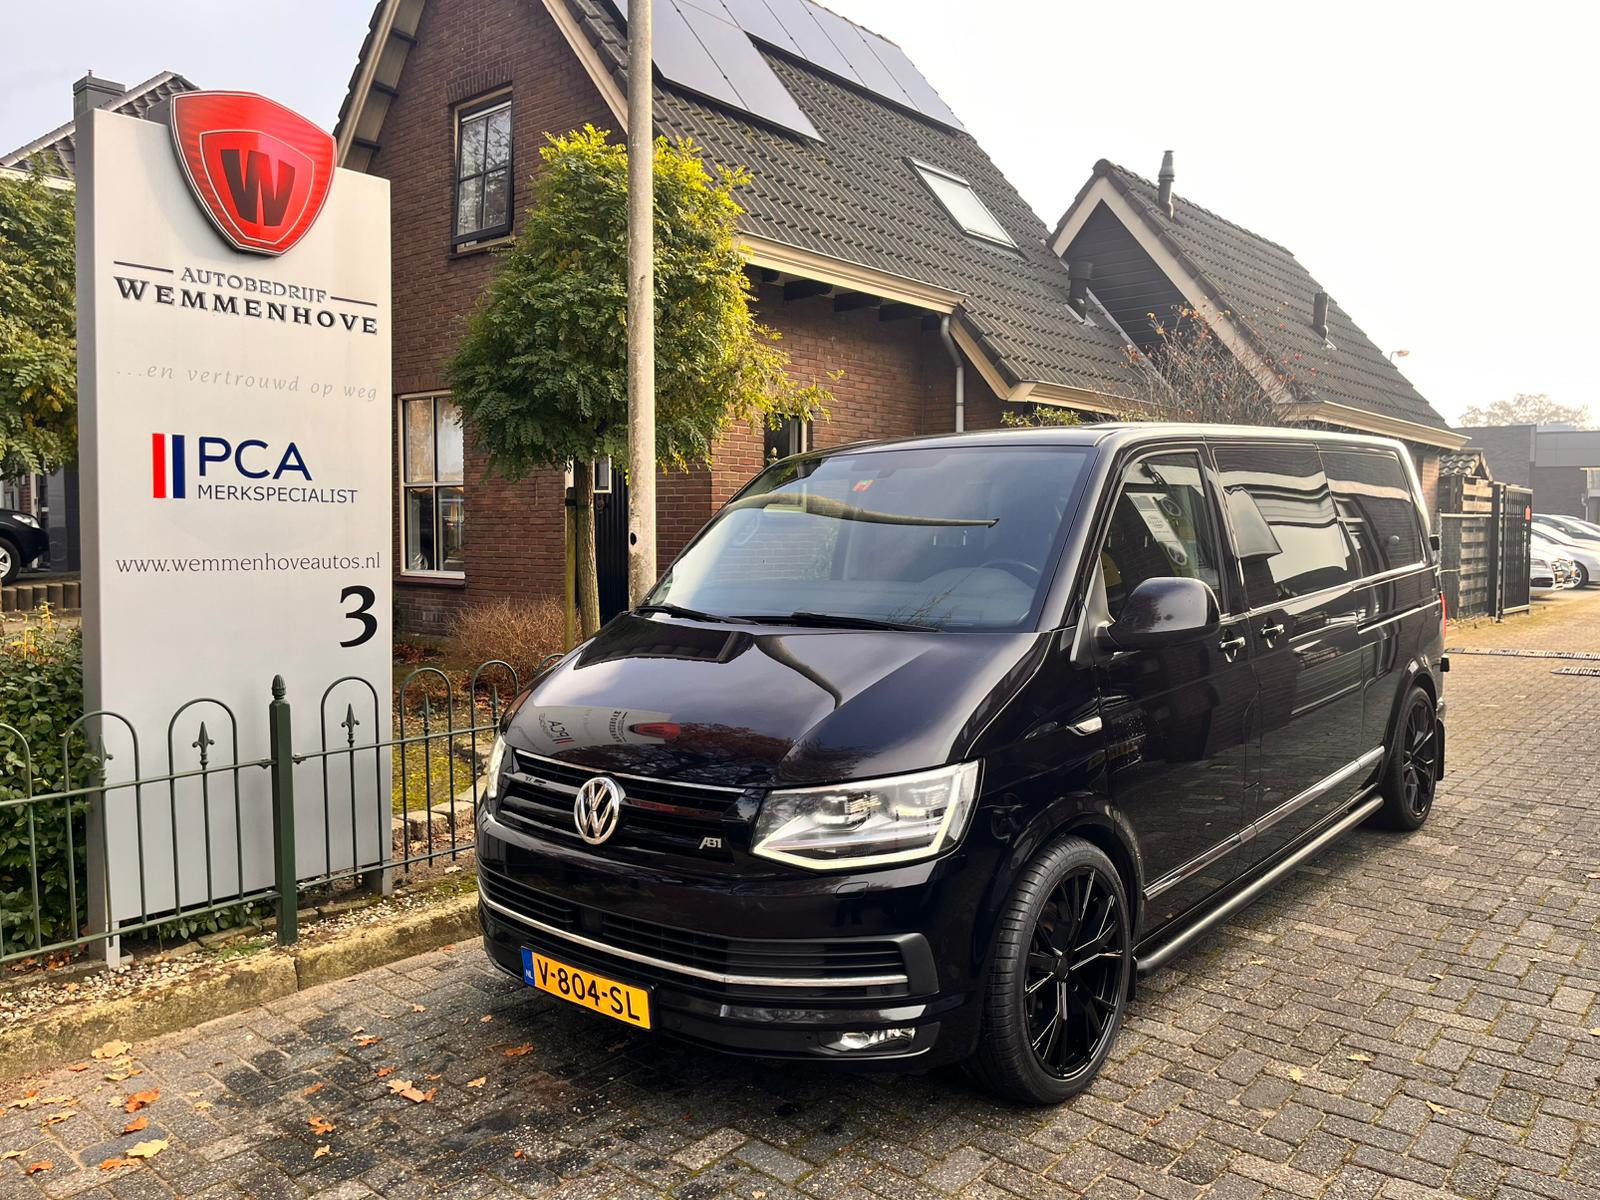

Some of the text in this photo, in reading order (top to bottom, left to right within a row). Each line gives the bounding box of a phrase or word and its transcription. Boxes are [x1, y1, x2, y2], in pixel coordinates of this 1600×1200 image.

[219, 148, 296, 227] W
[180, 266, 327, 303] AUTOBEDRIJF
[113, 275, 378, 336] WEMMENHOVE
[187, 367, 300, 393] vertrouwd
[310, 381, 333, 398] op
[343, 385, 378, 403] weg
[198, 436, 313, 481] PCA
[197, 484, 358, 504] MERKSPECIALIST
[115, 552, 381, 573] www.wemmenhoveautos.nl
[338, 585, 378, 648] 3
[525, 969, 534, 980] NL
[537, 958, 641, 1022] V-804-SL
